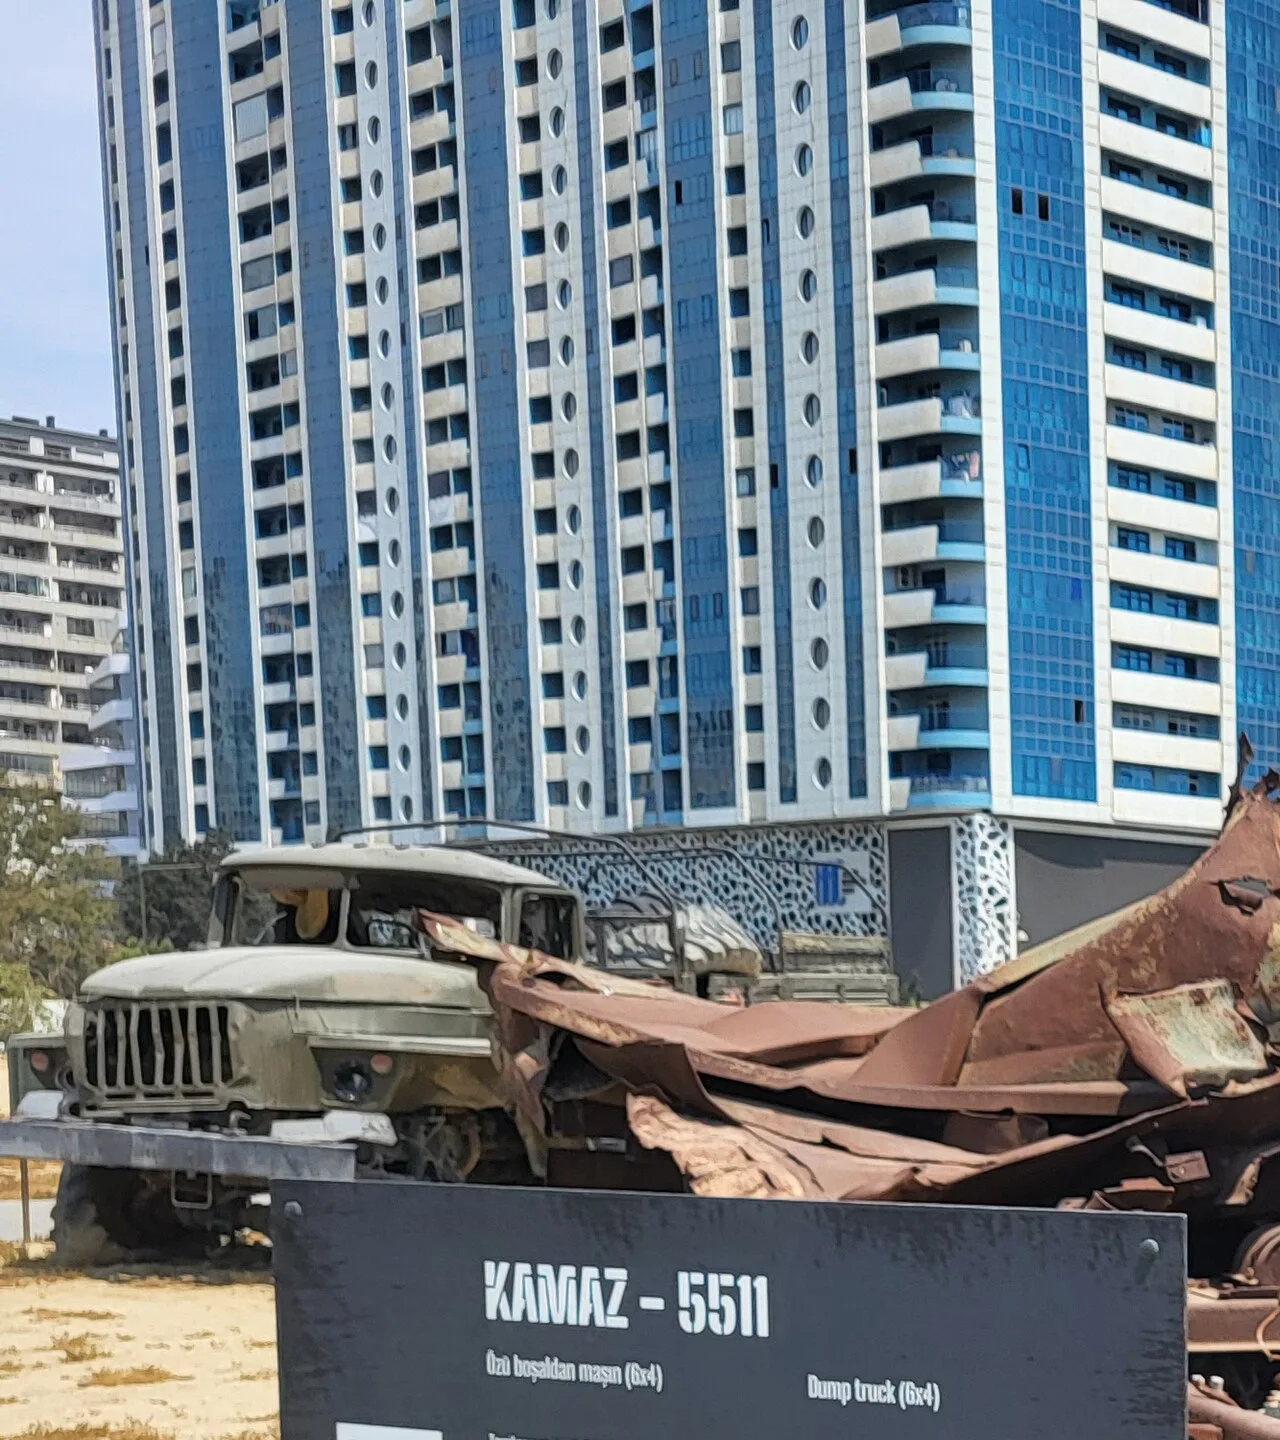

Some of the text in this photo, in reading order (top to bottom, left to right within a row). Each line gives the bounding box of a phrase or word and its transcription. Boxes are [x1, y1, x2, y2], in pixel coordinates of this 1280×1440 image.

[483, 1260, 770, 1338] KAMAZ - 5511
[513, 1354, 576, 1384] boşaldan
[579, 1362, 622, 1389] maşın
[625, 1362, 664, 1393] (6x4)
[807, 1373, 942, 1413] Dump truck (6x4)
